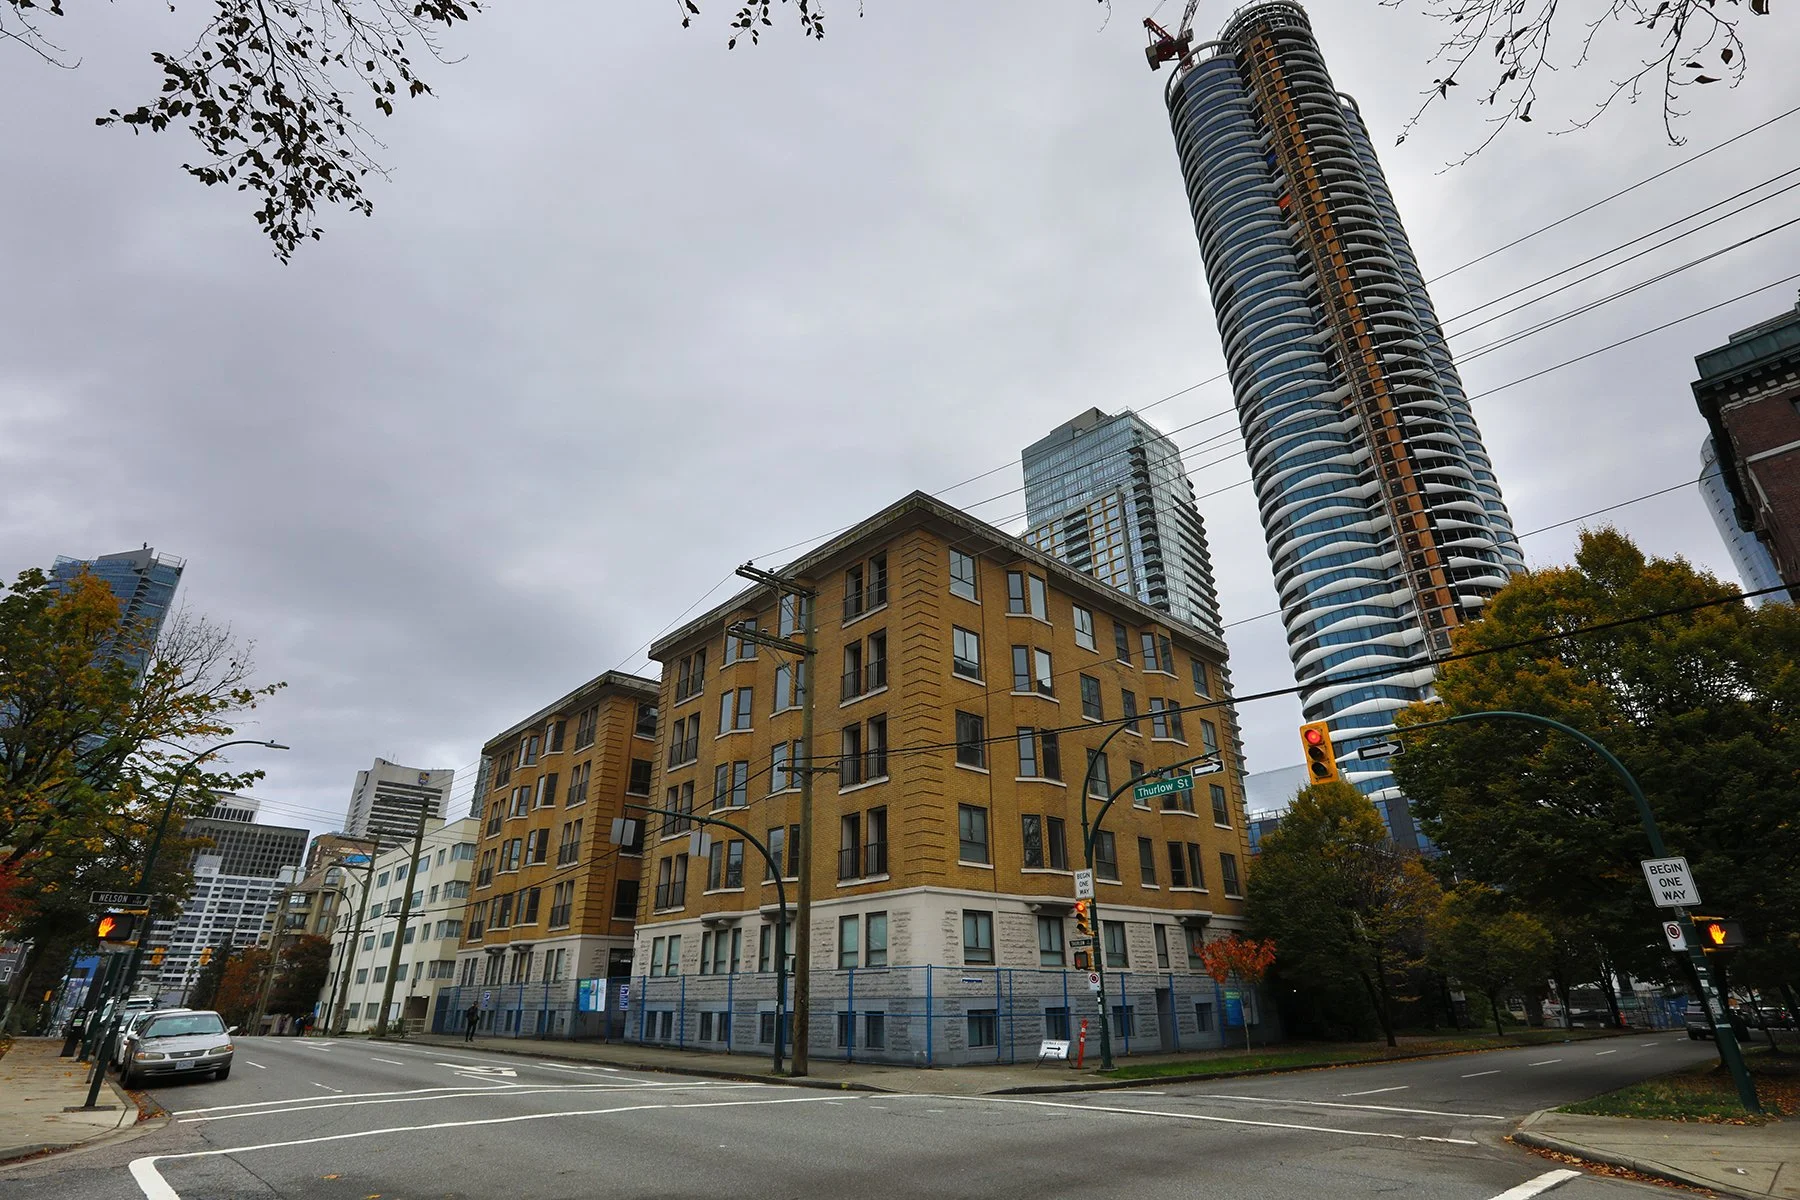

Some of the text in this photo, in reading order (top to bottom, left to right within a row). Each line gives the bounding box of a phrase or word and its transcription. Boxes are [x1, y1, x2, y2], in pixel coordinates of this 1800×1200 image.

[1138, 778, 1189, 797] Thurlow St
[1649, 863, 1683, 875] BEGIN
[1076, 872, 1090, 880] BEGIN
[1079, 880, 1089, 888] ONE
[1659, 877, 1683, 887] ONE
[98, 894, 128, 903] NELSON
[1662, 890, 1686, 900] WAY
